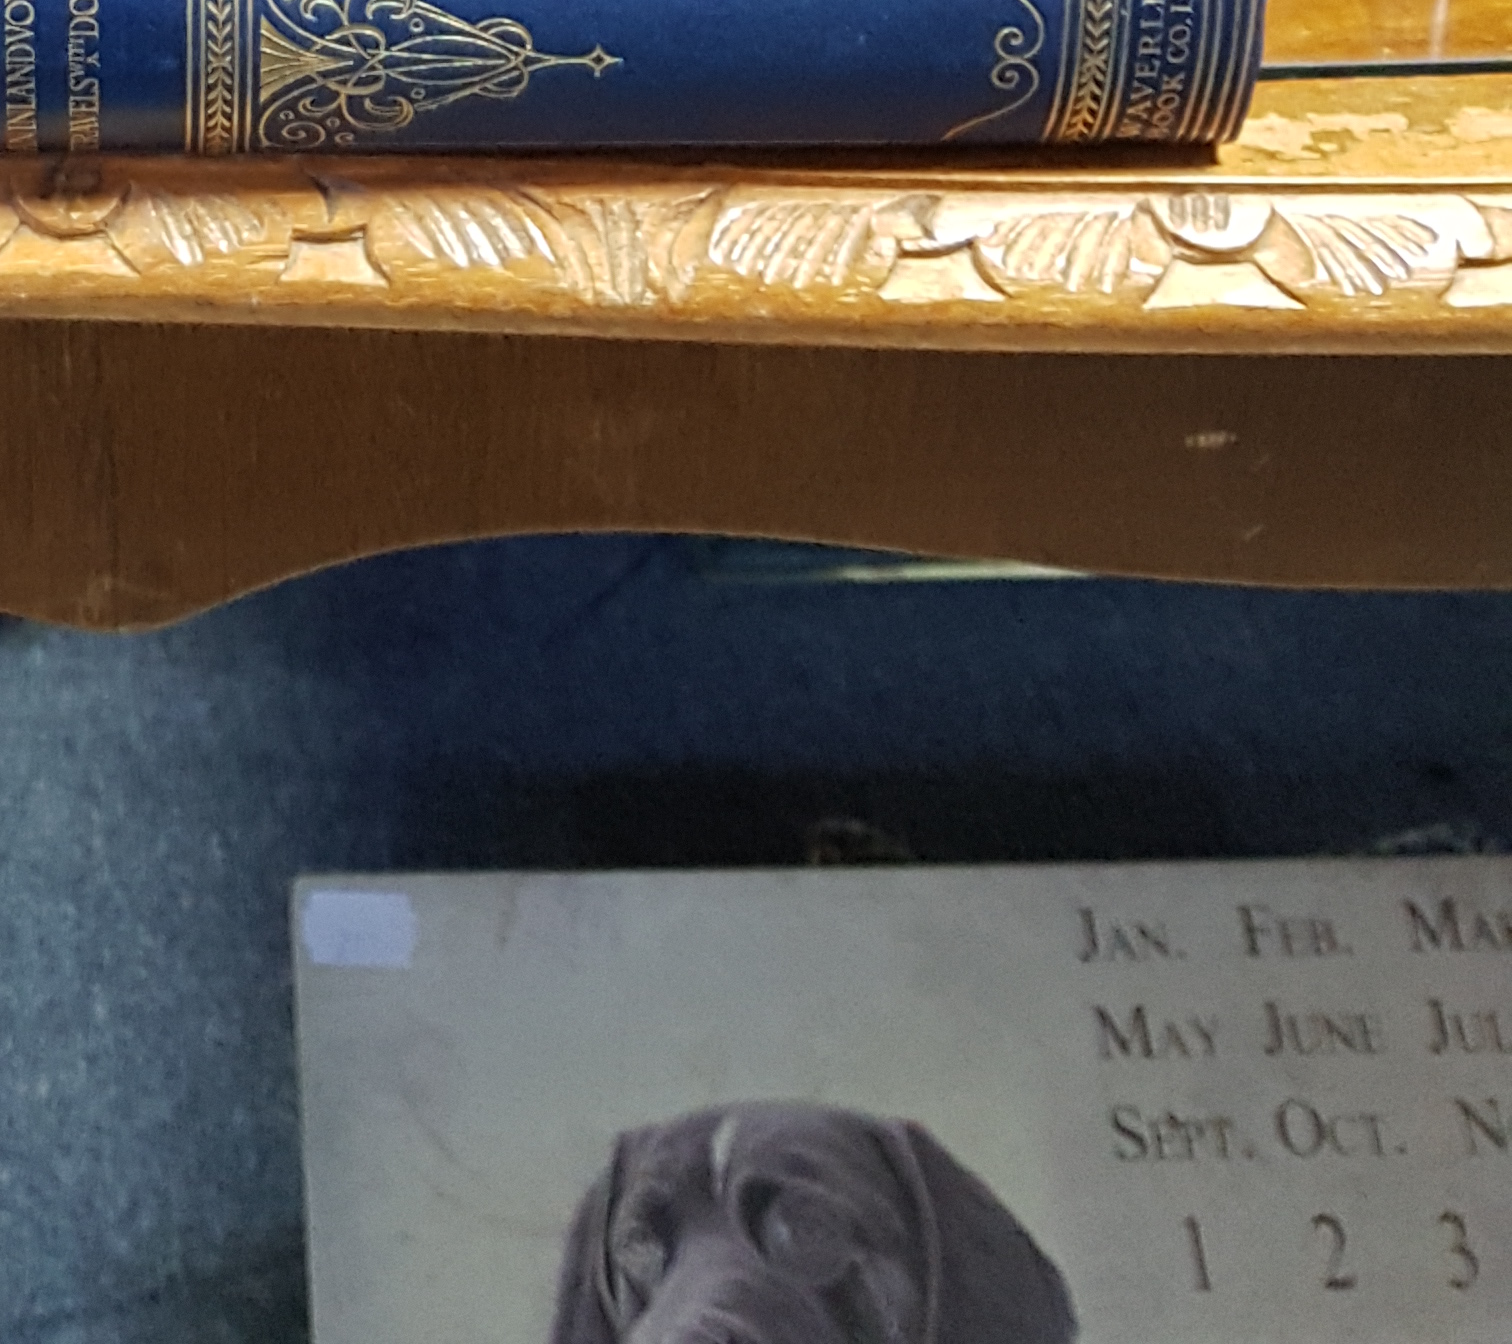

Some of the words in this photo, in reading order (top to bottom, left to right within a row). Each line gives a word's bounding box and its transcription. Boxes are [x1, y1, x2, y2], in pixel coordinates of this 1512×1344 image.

[1167, 18, 1193, 63] CO.
[1185, 1215, 1211, 1292] 1
[1312, 1213, 1357, 1291] 2
[1440, 1210, 1479, 1291] 3
